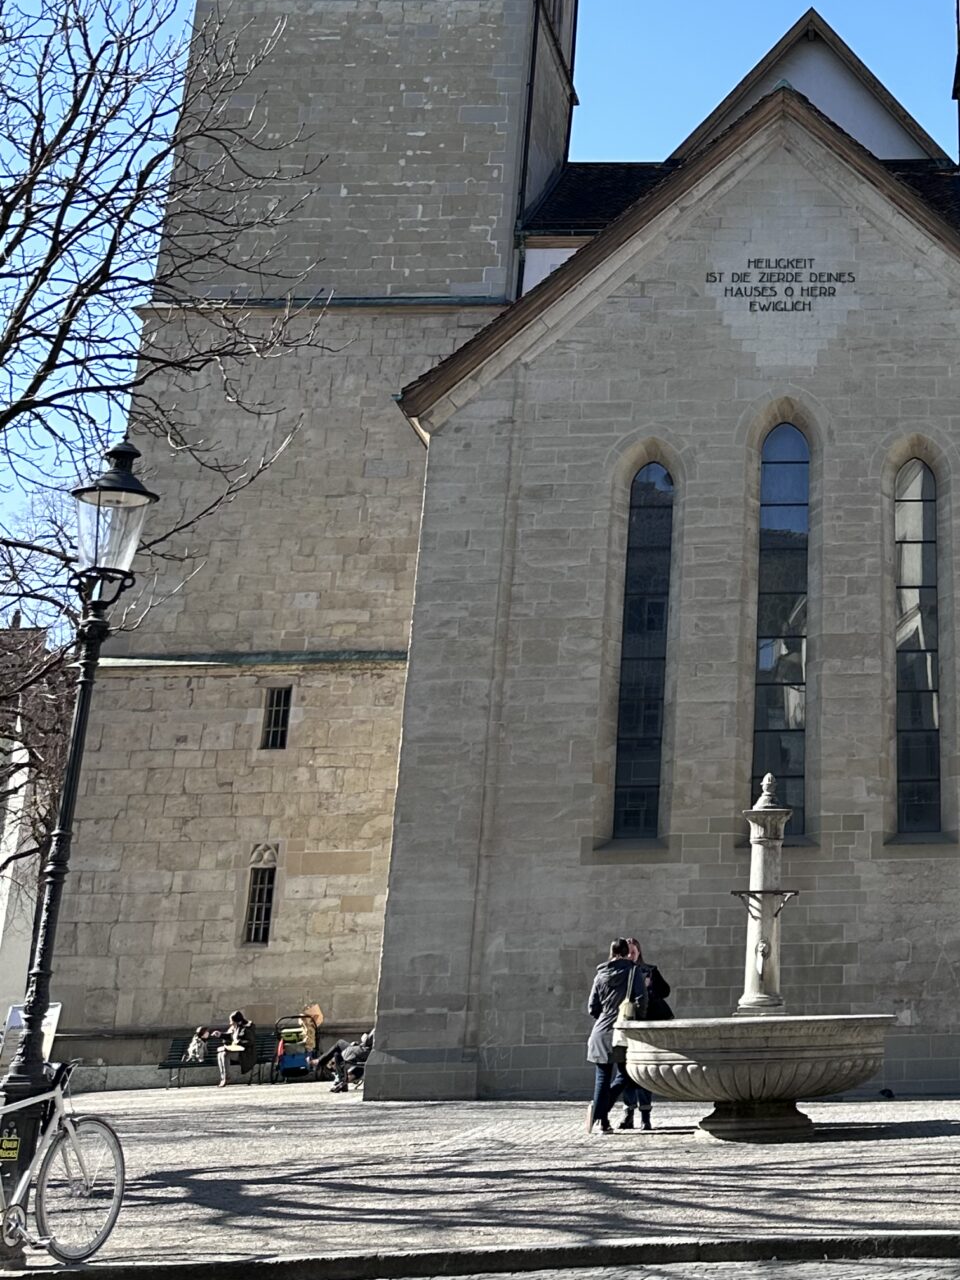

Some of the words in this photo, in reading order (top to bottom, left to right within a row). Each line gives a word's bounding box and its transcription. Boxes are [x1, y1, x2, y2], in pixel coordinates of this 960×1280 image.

[747, 258, 815, 269] HEILIGKEIT
[706, 272, 725, 283] IST
[732, 272, 751, 283] DIE
[758, 272, 803, 283] ZIERDE
[809, 272, 856, 283] DEINES
[724, 286, 777, 297] HAUSES
[784, 286, 794, 297] O
[801, 286, 836, 297] HERR
[749, 300, 812, 312] EWIGLICH
